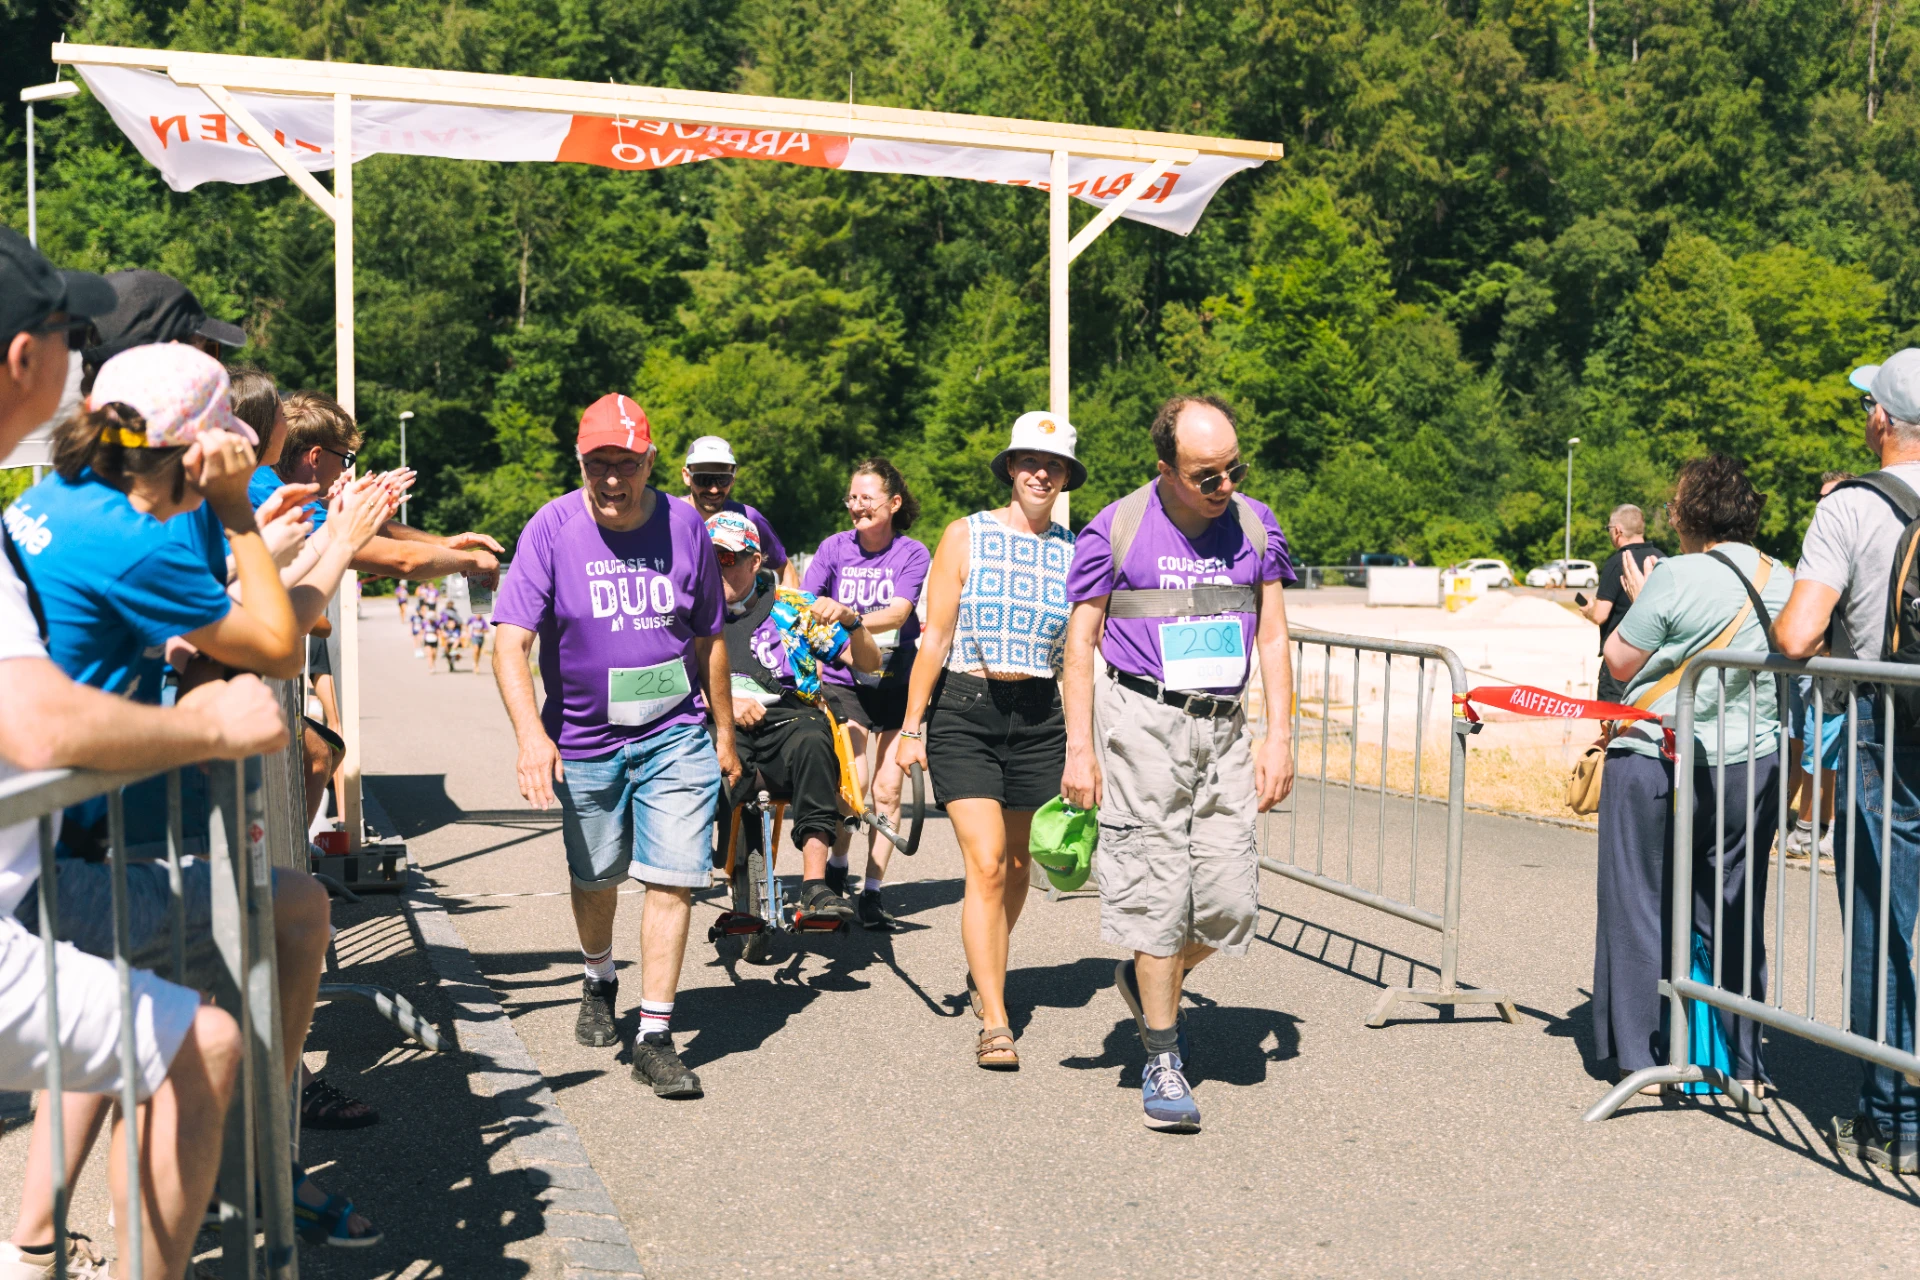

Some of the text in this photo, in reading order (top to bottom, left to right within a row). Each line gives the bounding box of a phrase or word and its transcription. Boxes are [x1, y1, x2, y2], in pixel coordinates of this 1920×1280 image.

[585, 558, 647, 576] COURSE
[841, 566, 882, 578] COURSE
[1157, 556, 1216, 574] COURSE
[589, 575, 675, 618] DUO
[838, 579, 894, 606] DUO
[632, 616, 675, 630] SUISSE
[1179, 626, 1235, 655] 208
[635, 668, 675, 695] 28
[1509, 688, 1585, 718] RAIFFEISEN
